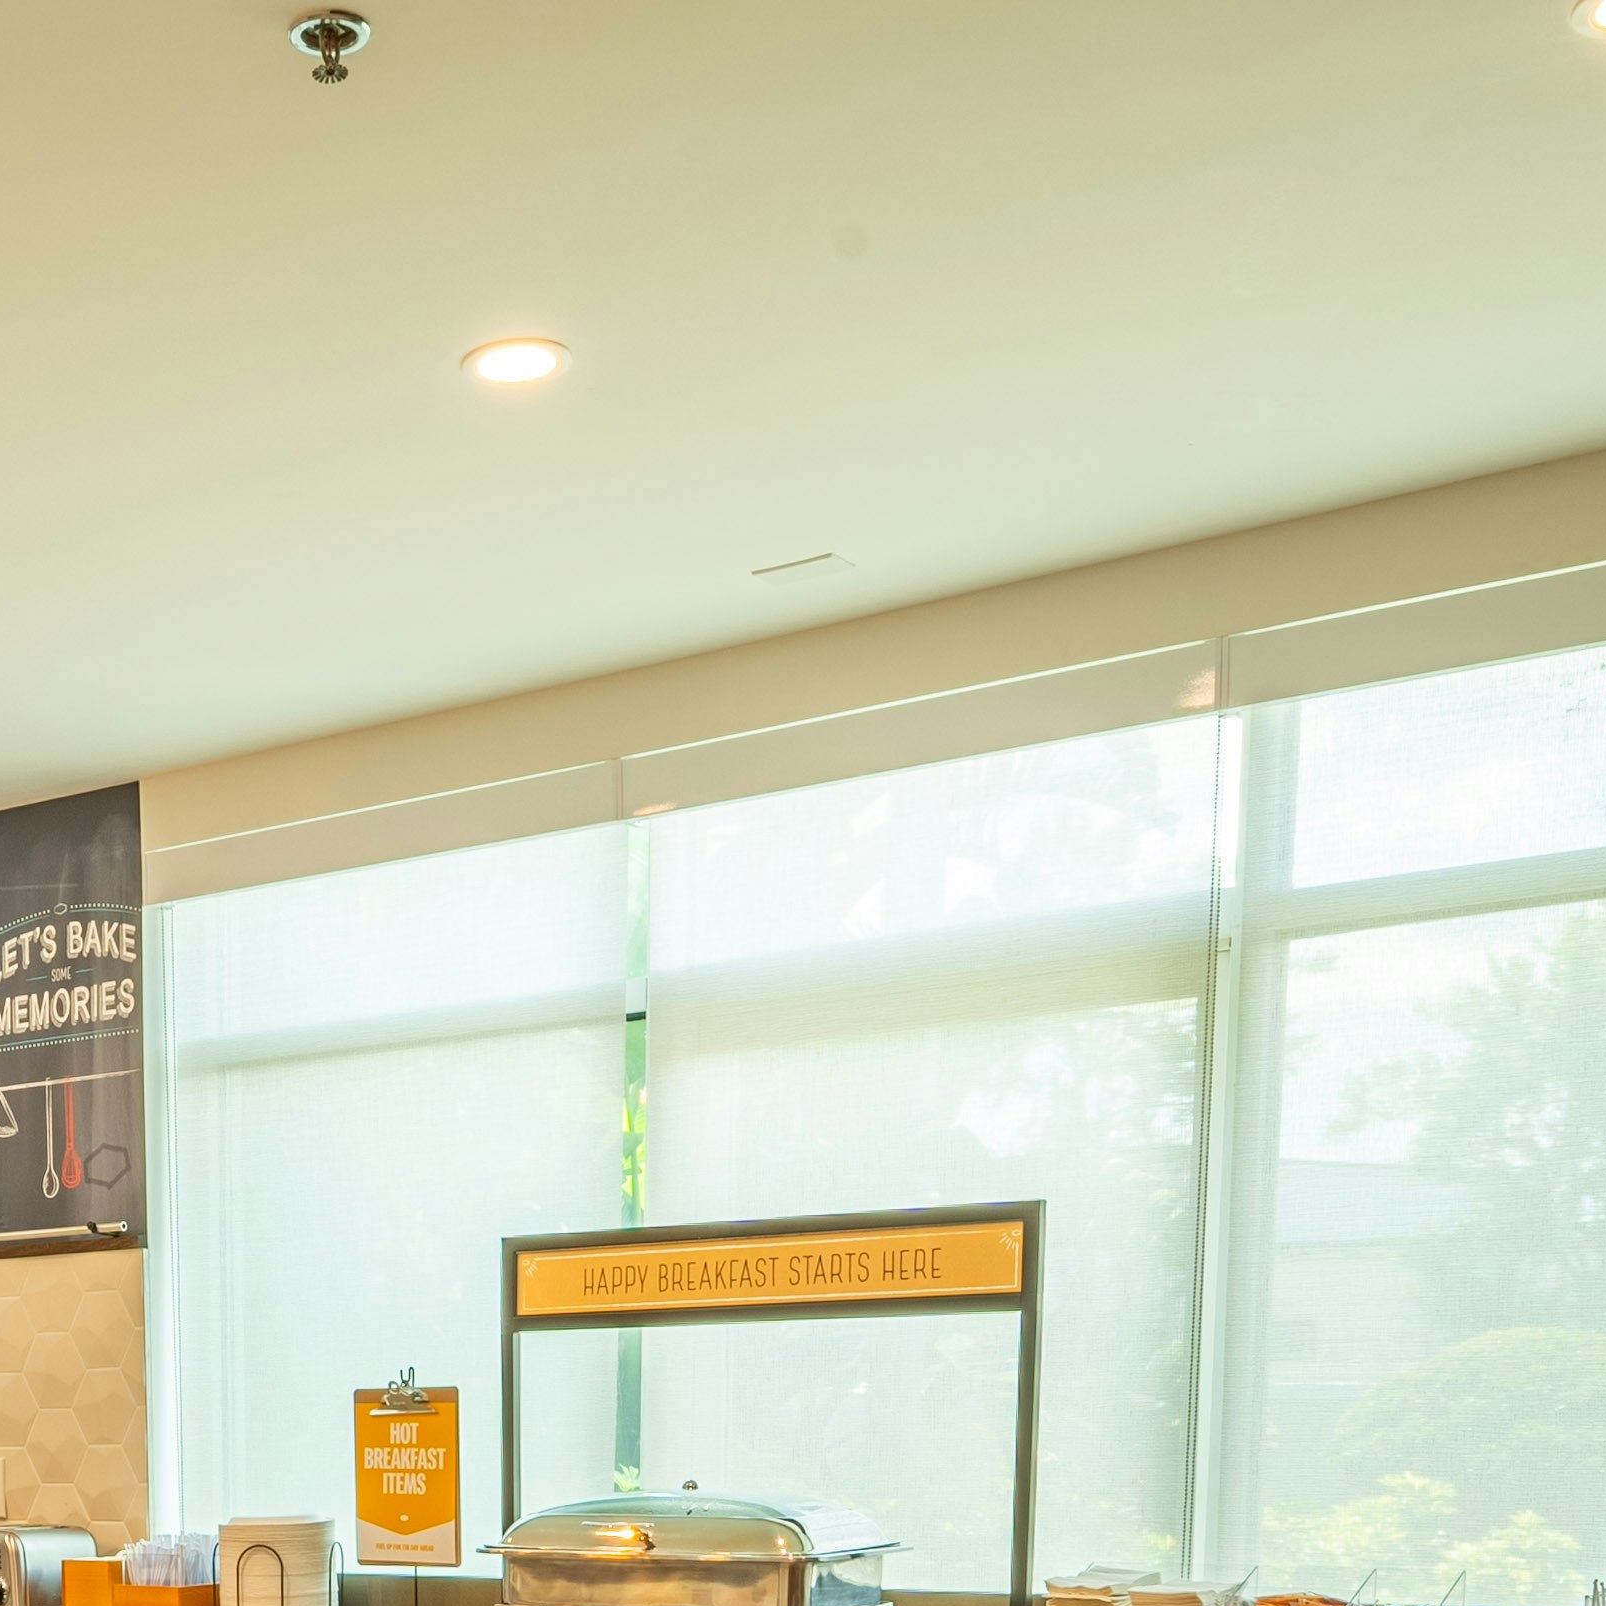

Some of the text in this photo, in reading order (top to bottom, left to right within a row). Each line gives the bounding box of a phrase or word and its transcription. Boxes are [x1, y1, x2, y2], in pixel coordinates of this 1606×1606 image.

[66, 920, 137, 963] BAKE
[51, 966, 72, 982] SOME
[583, 1247, 942, 1296] HAPPY BREAKFAST STARTS HERE
[390, 1422, 419, 1444] HOT
[364, 1448, 446, 1470] BREAKFAST
[382, 1473, 426, 1495] ITEMS
